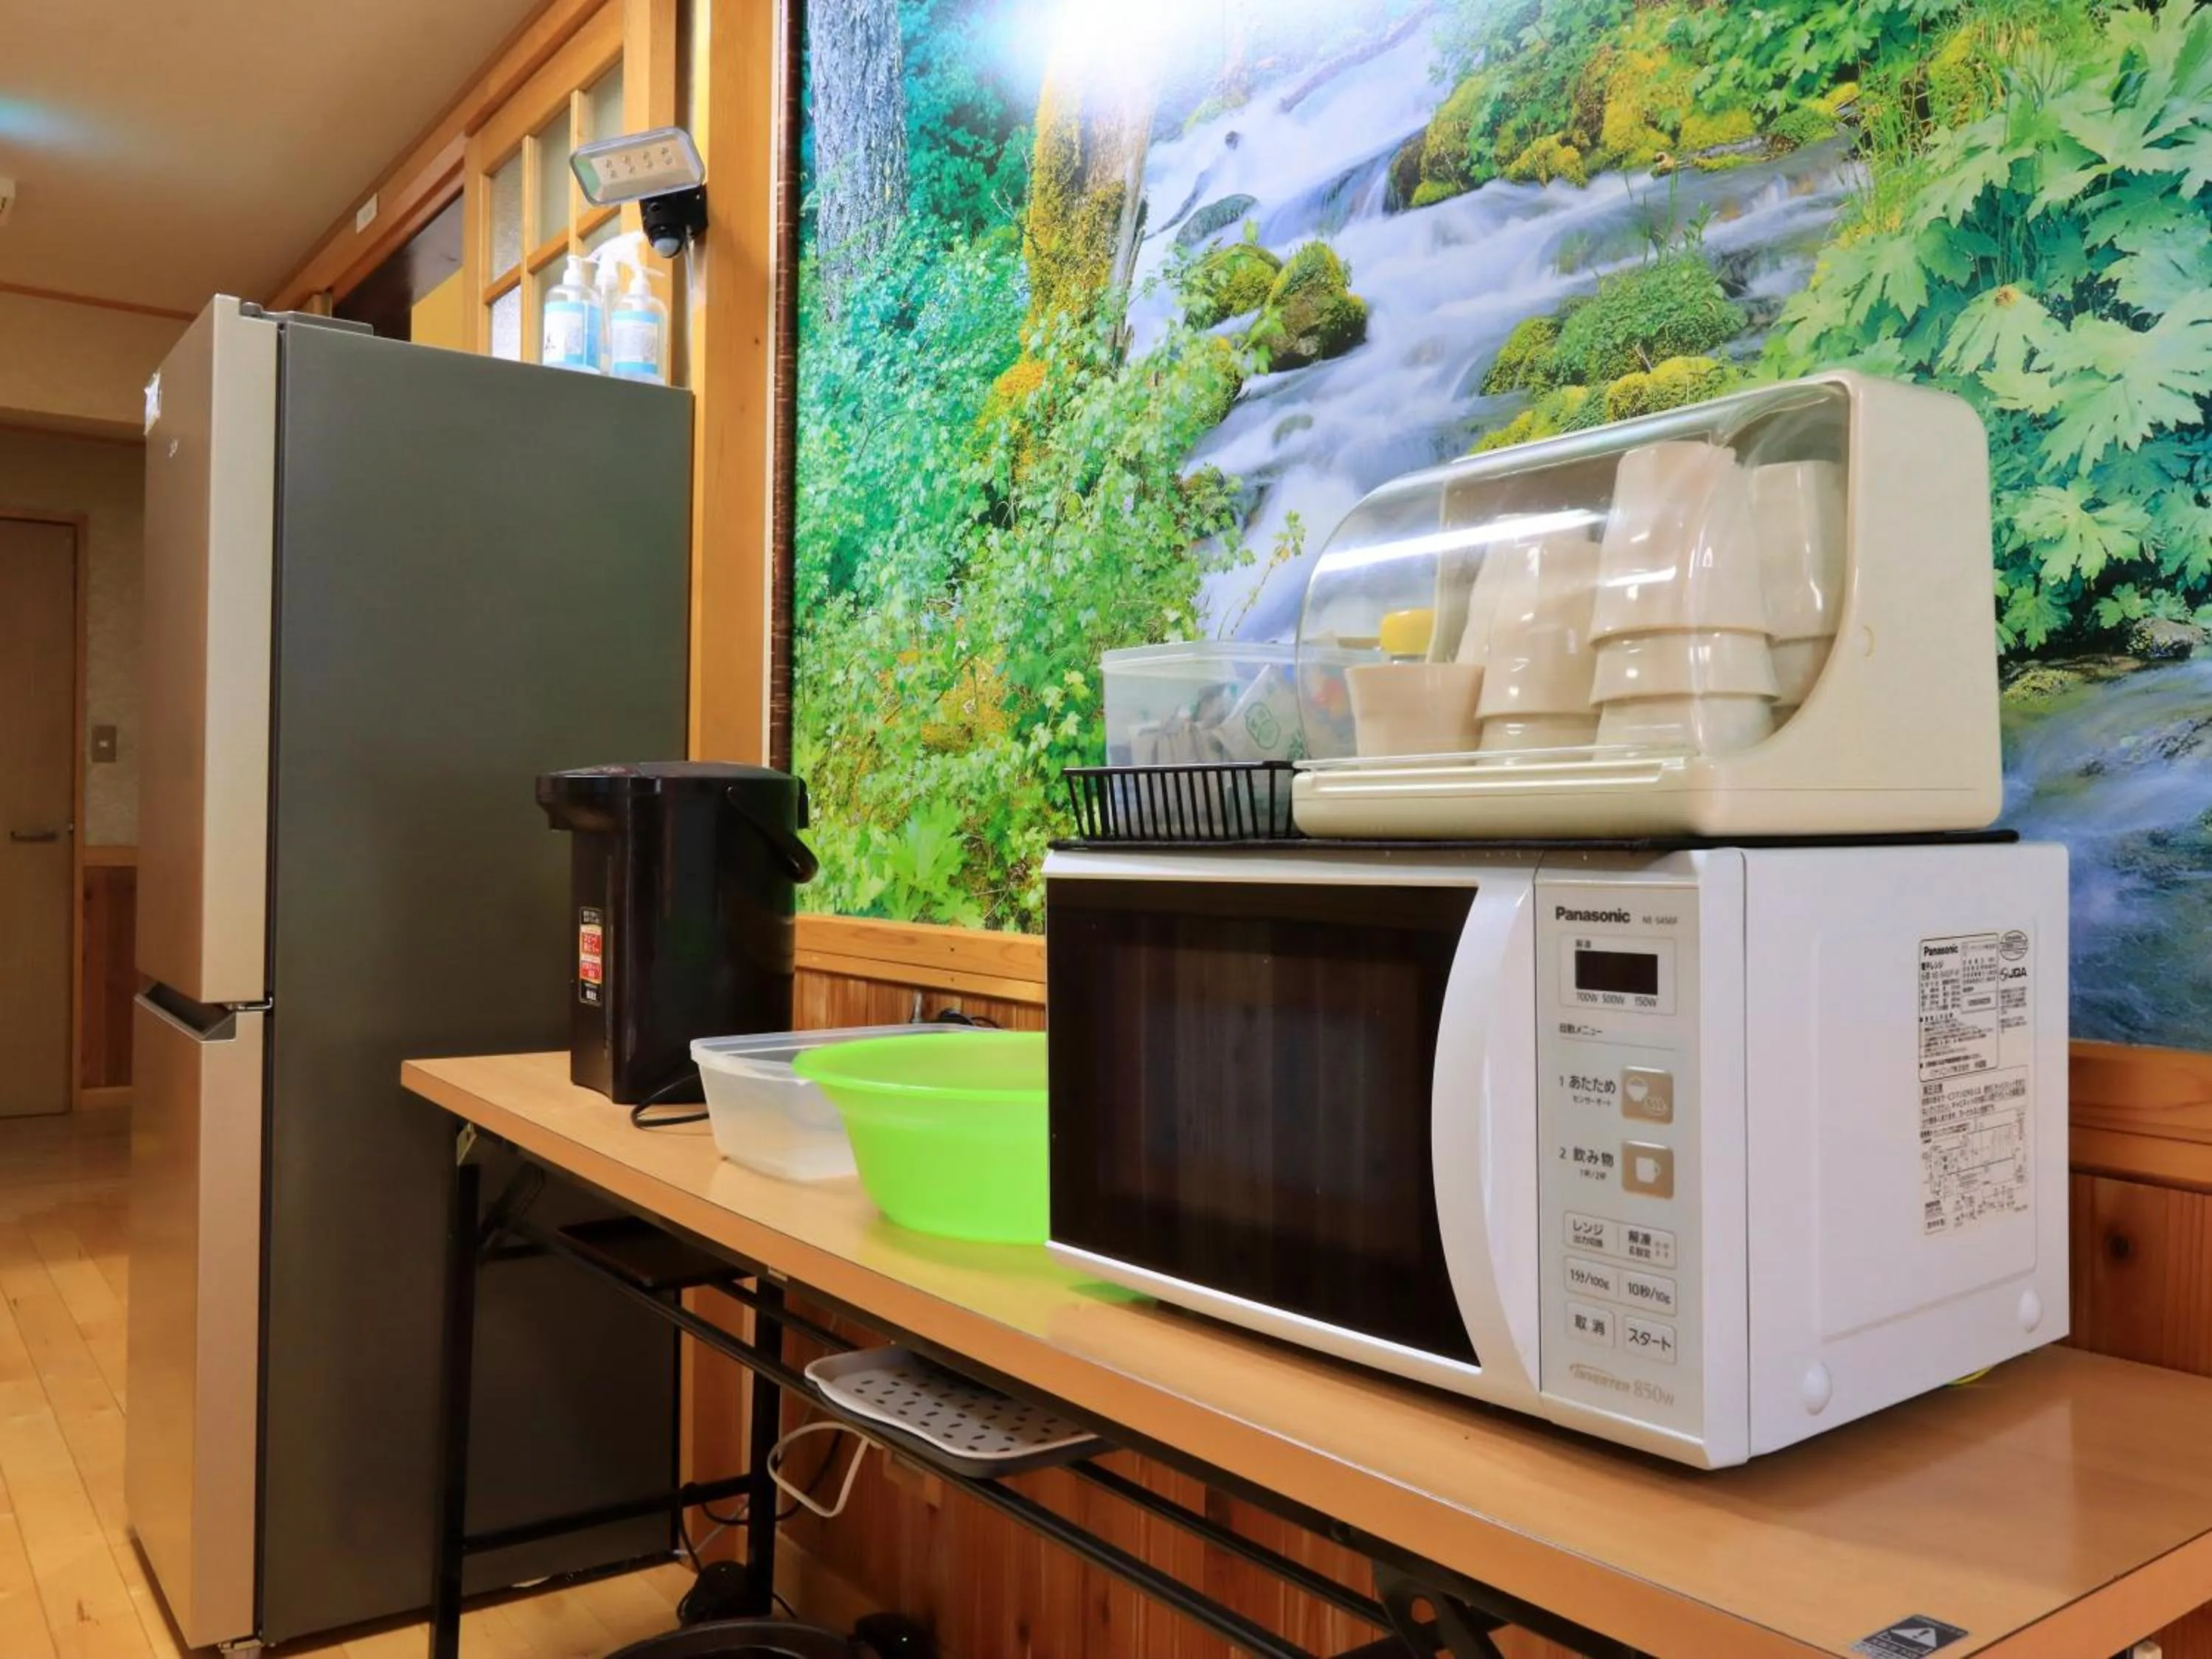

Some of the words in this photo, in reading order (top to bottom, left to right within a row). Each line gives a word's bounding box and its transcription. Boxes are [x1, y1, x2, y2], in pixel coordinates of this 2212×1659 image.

[1555, 906, 1631, 923] Panasonic
[1924, 944, 1958, 957] Panasonic
[1576, 993, 1598, 1003] 700W
[1602, 994, 1625, 1005] 500W
[1559, 1076, 1564, 1086] 1
[1569, 1076, 1616, 1094] あたため
[1559, 1147, 1566, 1159] 2
[1573, 1147, 1615, 1168] 飲み物
[1573, 1219, 1604, 1235] レンジ
[1628, 1230, 1651, 1247] 解凍
[1628, 1327, 1672, 1352] スタート
